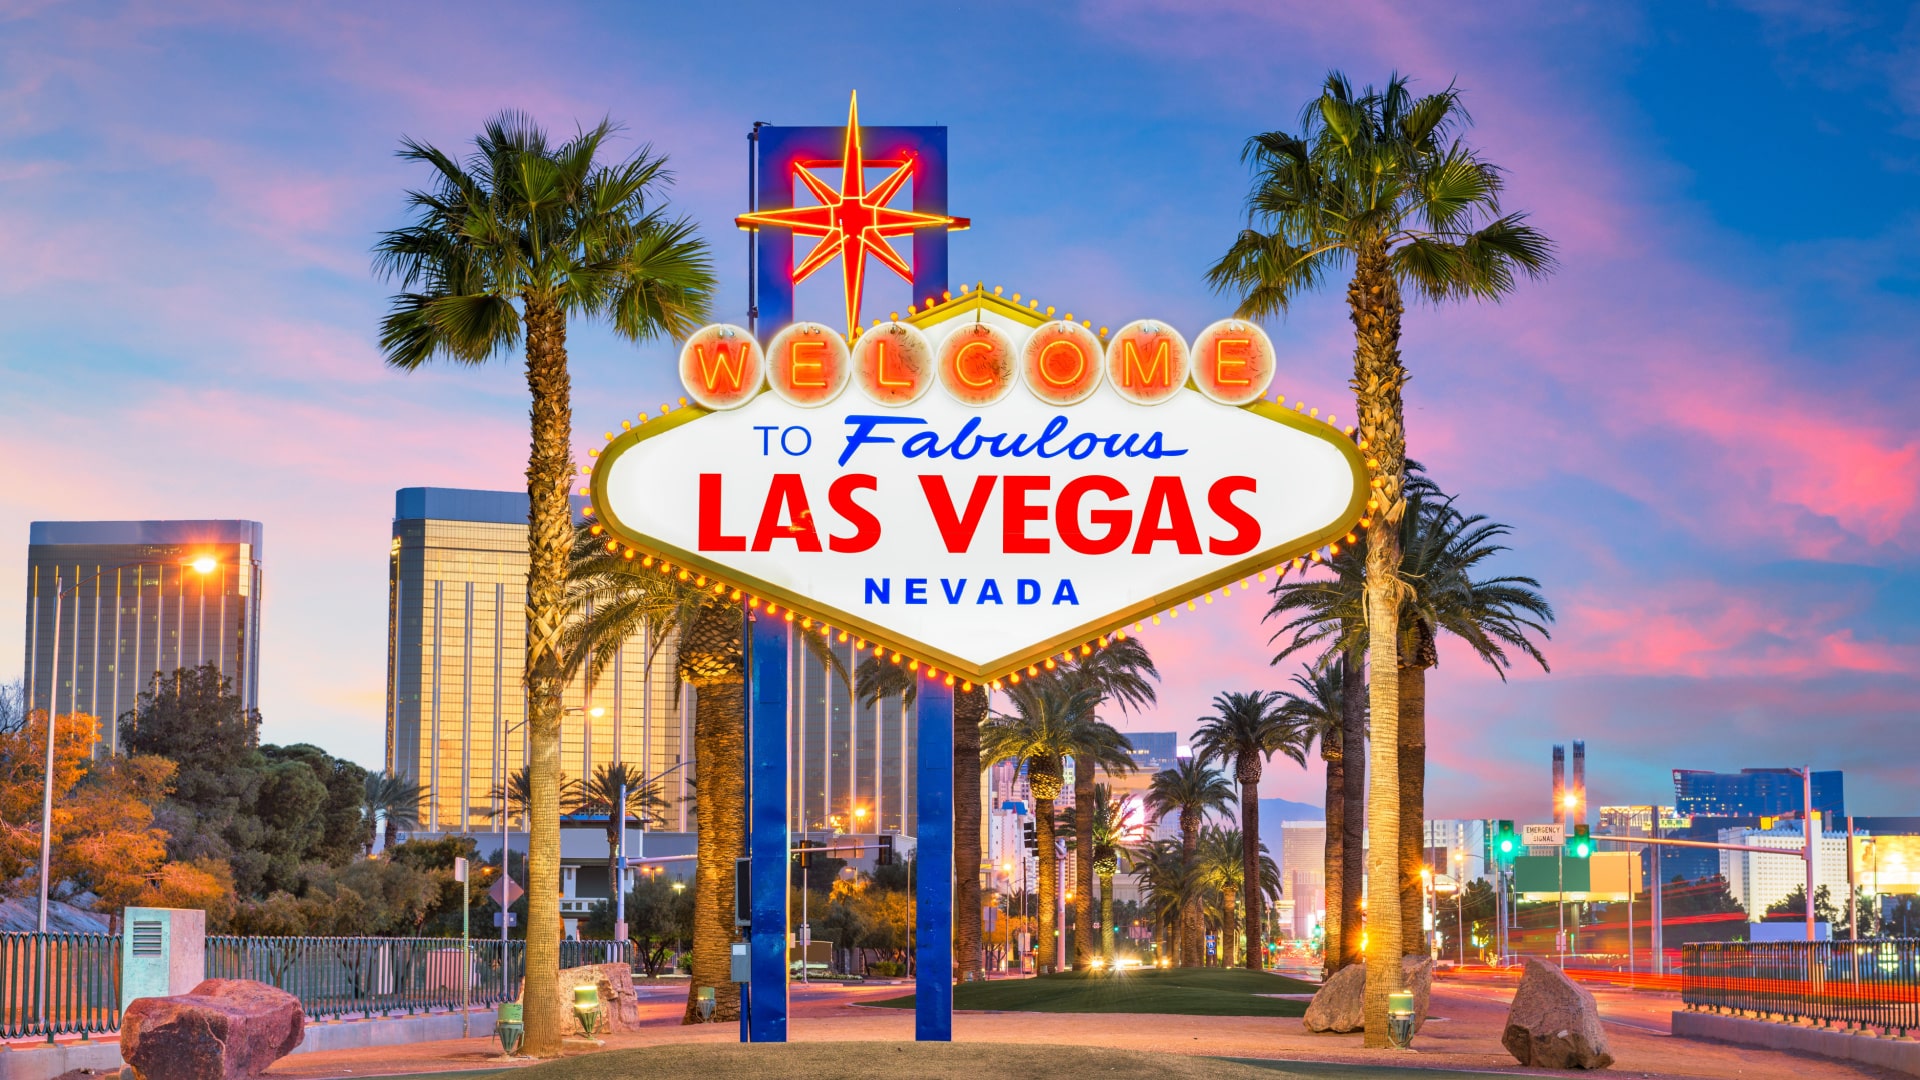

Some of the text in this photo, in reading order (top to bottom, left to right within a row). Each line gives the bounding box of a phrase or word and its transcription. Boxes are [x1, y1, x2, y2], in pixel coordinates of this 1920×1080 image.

[695, 337, 1252, 393] WELCOME
[754, 415, 1188, 467] TO Fabulous
[698, 473, 1262, 556] LAS VEGAS
[864, 577, 1080, 606] NEVADA
[1526, 826, 1561, 834] EMERGENCY
